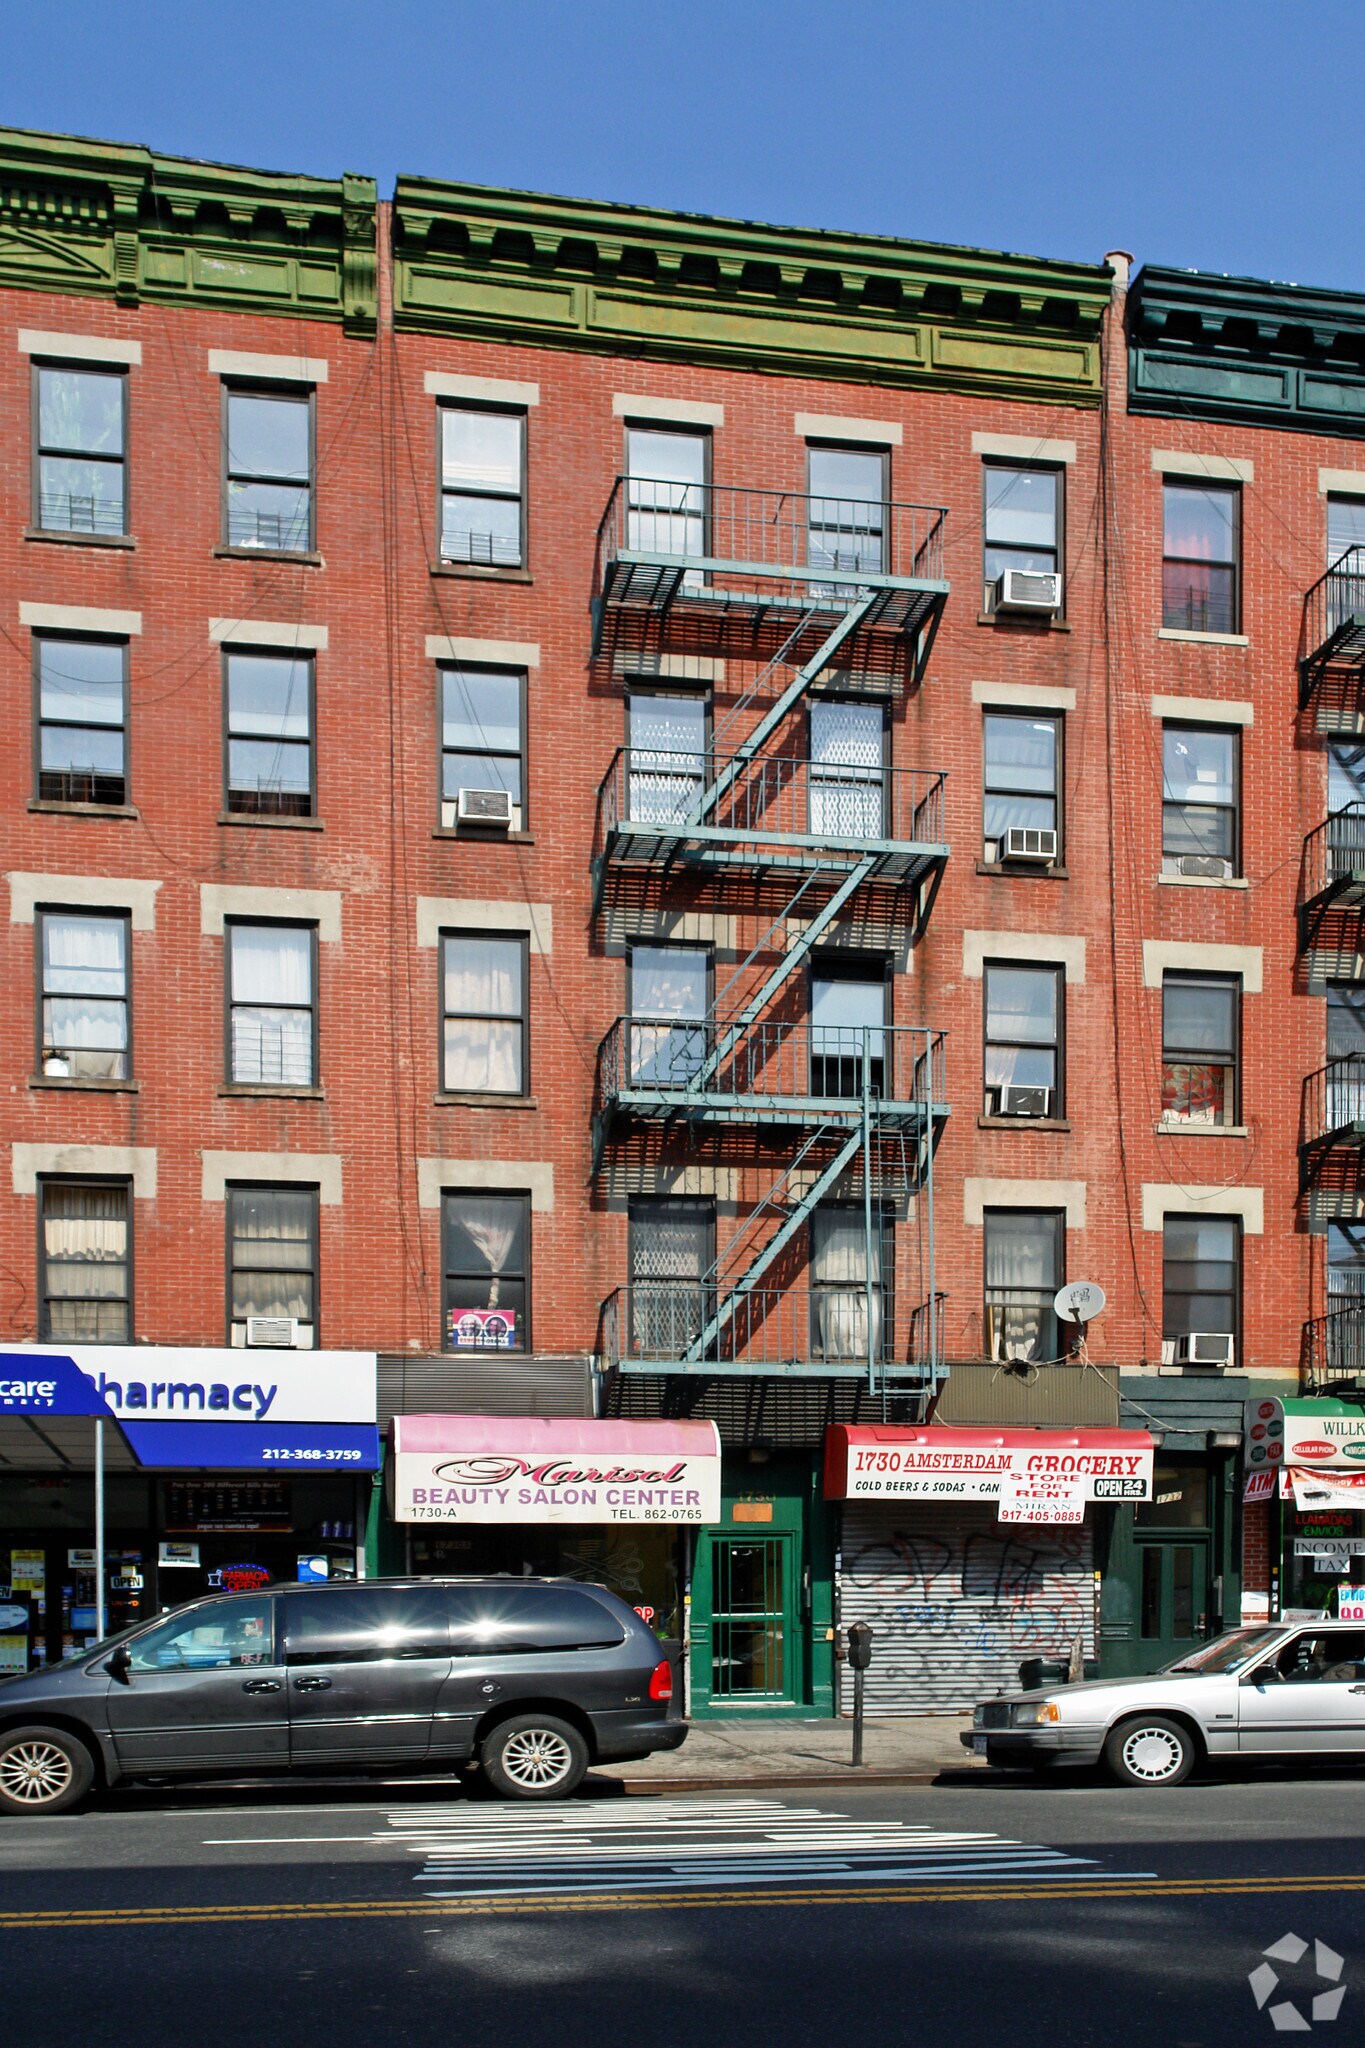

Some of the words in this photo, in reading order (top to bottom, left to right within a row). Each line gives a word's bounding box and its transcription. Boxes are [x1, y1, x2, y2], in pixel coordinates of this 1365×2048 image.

[0, 1380, 55, 1397] care
[262, 1448, 362, 1460] 212-368-3759
[1293, 1445, 1318, 1454] CELLULAR
[1318, 1446, 1335, 1454] PHONE
[855, 1452, 901, 1472] 1730
[904, 1453, 1013, 1469] AMSTERDAM
[1027, 1455, 1143, 1475] GROCERY
[432, 1457, 687, 1486] Marisol
[1010, 1473, 1080, 1482] STORE
[855, 1481, 882, 1491] COLD
[886, 1481, 919, 1491] BEERS
[933, 1482, 966, 1492] SODAS
[979, 1483, 1001, 1493] CAN
[1096, 1480, 1122, 1496] OPEN
[1123, 1480, 1143, 1490] 24
[1247, 1472, 1273, 1494] ATM
[413, 1488, 510, 1504] BEAUTY
[518, 1489, 597, 1505] SALON
[606, 1490, 700, 1506] CENTER
[1016, 1490, 1073, 1498] RENT
[1016, 1502, 1071, 1510] MIRAN
[411, 1507, 457, 1518] 1730-A
[610, 1509, 640, 1519] TEL.
[644, 1509, 702, 1520] 862-0765
[1303, 1526, 1344, 1536] ENVIOS
[1296, 1542, 1362, 1554] INCOME
[1316, 1559, 1349, 1571] TAX
[113, 1576, 141, 1588] OPEN
[222, 1571, 269, 1581] FARMACIA
